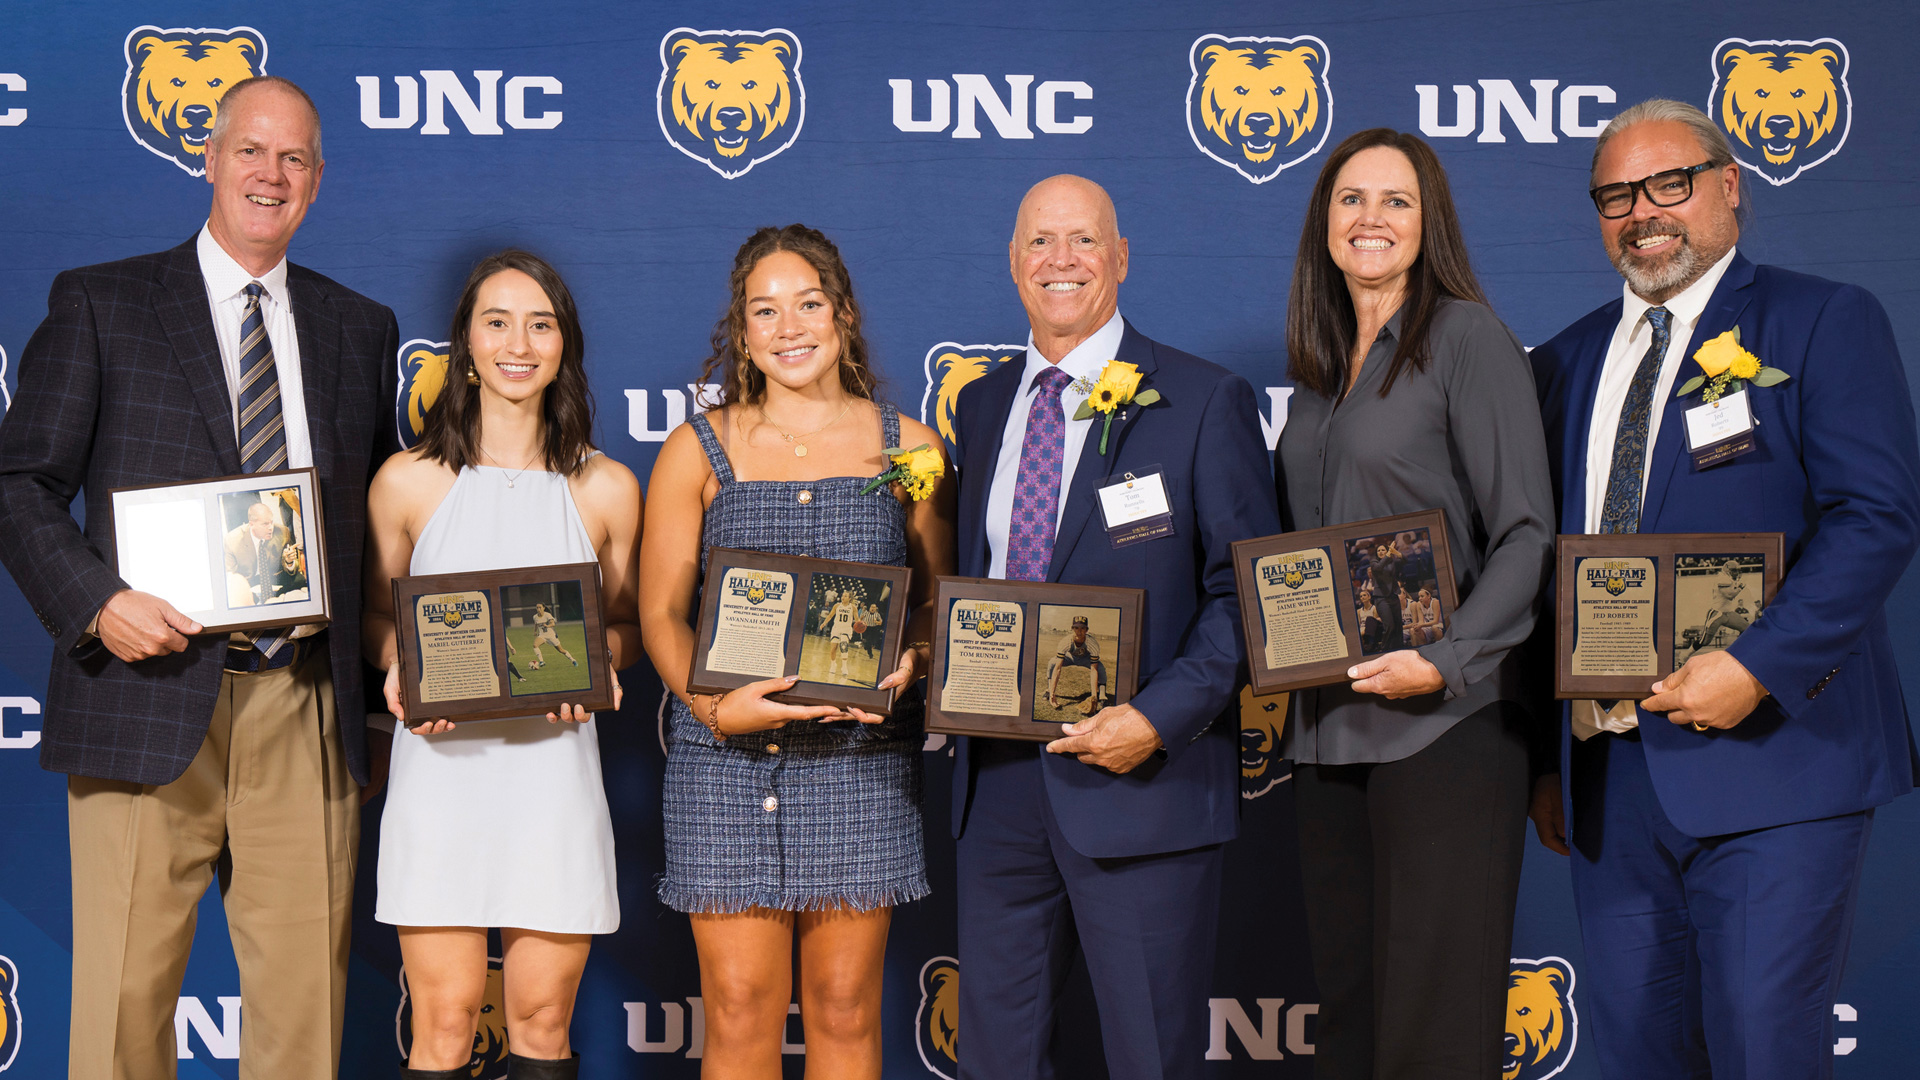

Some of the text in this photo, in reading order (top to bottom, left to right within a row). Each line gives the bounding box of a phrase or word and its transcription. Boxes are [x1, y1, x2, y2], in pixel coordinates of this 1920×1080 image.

[356, 70, 563, 135] UNC
[888, 73, 1093, 139] UNC
[1415, 79, 1617, 143] UNC
[1278, 554, 1304, 564] UNC
[1262, 565, 1290, 579] HALL
[1295, 558, 1323, 570] FAME
[1604, 561, 1629, 569] UNC
[747, 572, 772, 581] UNC
[1587, 569, 1614, 580] HALL
[1620, 569, 1646, 580] FAME
[729, 577, 755, 588] HALL
[761, 581, 787, 594] FAME
[439, 595, 464, 604] UNC
[1277, 599, 1320, 611] JAIME WHITE
[422, 604, 450, 616] HALL
[455, 601, 482, 612] FAME
[975, 603, 1000, 612] UNC
[725, 616, 757, 624] SAVANNAH
[839, 614, 848, 623] 10
[957, 609, 984, 621] HALL
[990, 612, 1016, 625] FAME
[451, 639, 484, 647] GUTIERREZ
